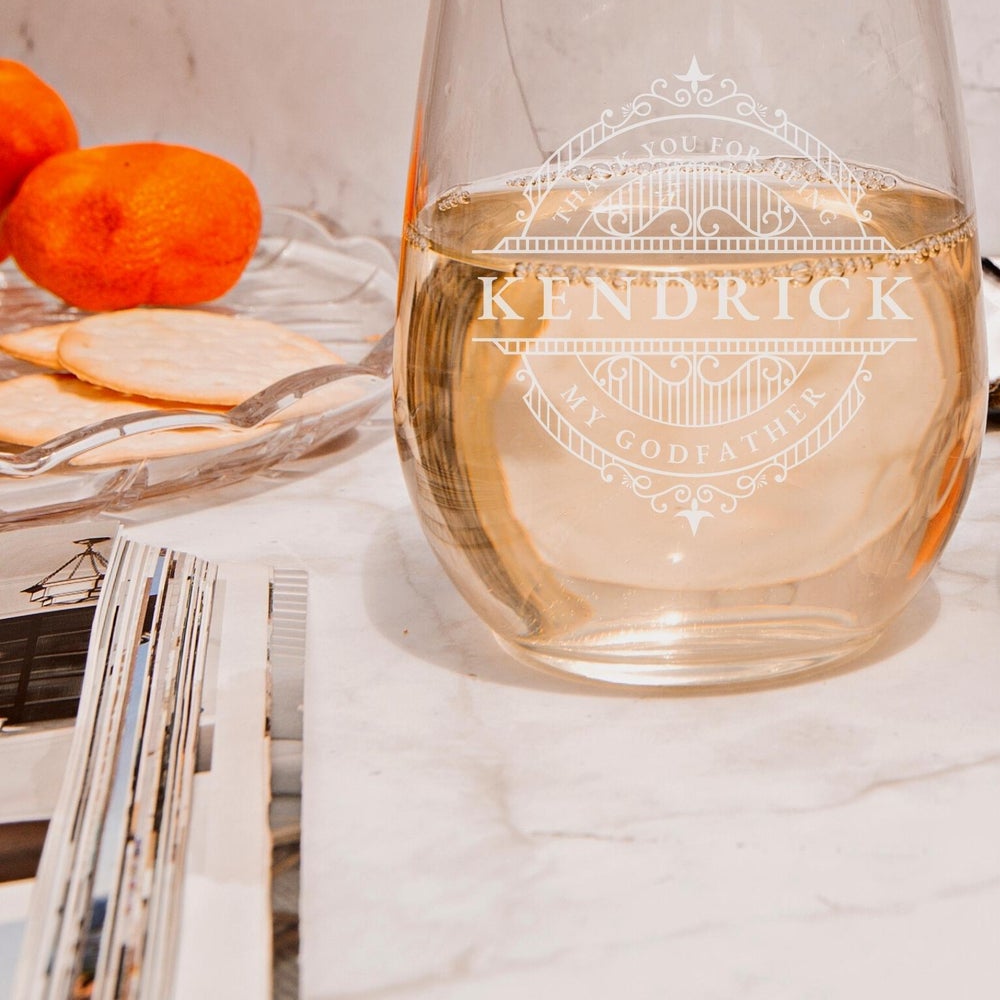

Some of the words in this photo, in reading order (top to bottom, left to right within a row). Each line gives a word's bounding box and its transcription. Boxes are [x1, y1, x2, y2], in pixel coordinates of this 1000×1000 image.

[641, 136, 698, 159] YOU
[711, 137, 761, 166] FOR
[477, 276, 915, 321] KENDRICK
[560, 384, 607, 428] MY
[615, 387, 826, 465] GODFATHER
